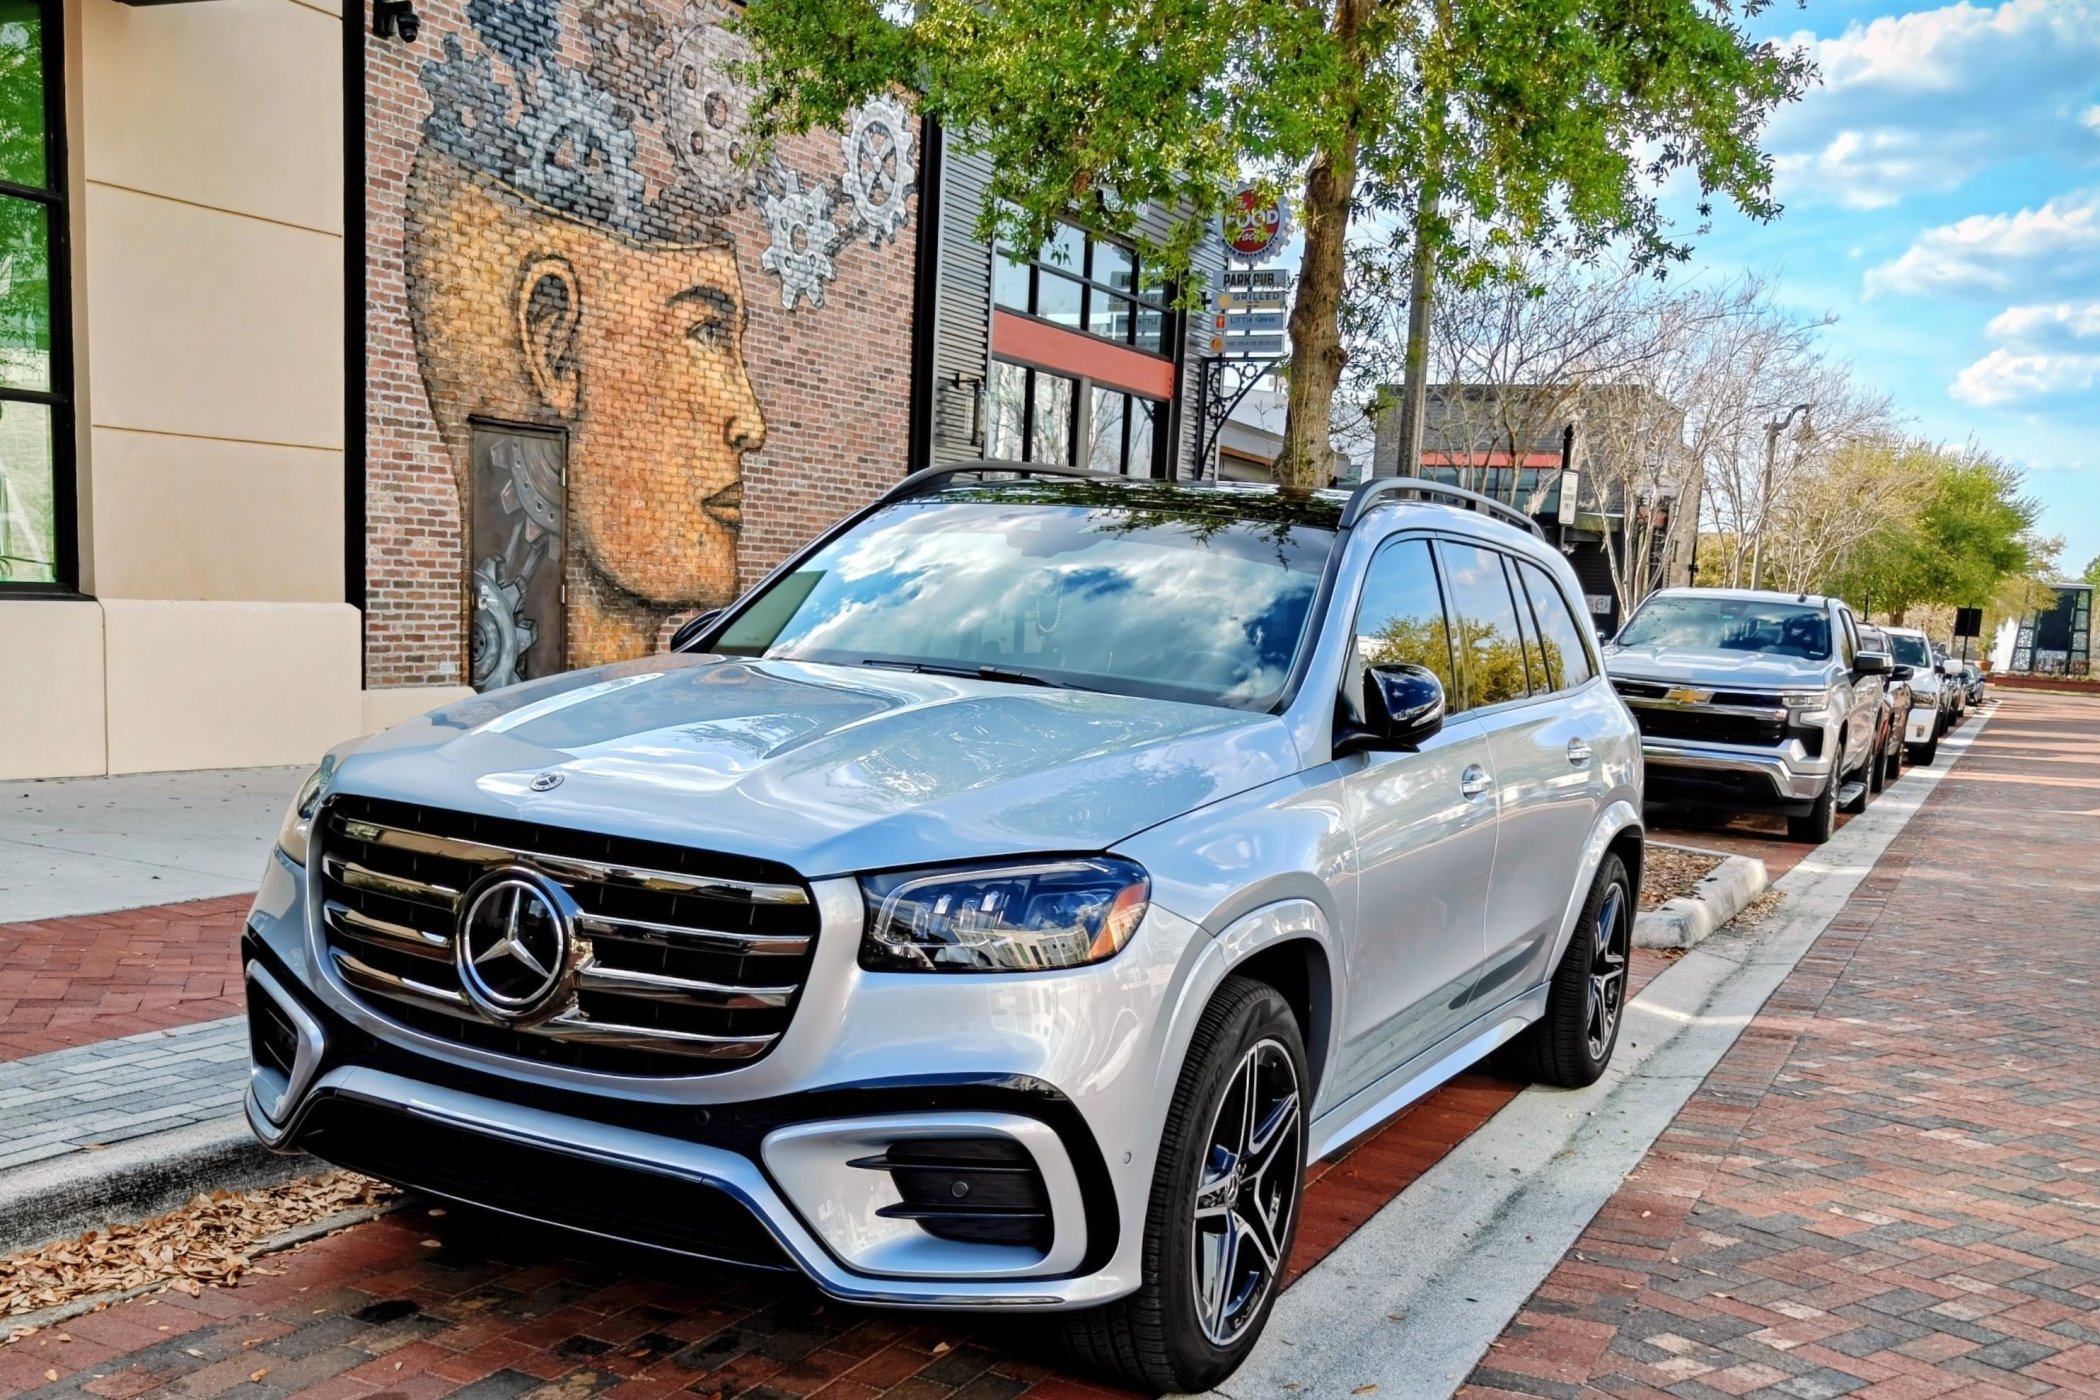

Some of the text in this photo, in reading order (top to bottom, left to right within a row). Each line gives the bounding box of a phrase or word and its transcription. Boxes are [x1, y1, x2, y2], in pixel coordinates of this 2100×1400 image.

[1223, 273, 1274, 287] PARK PUB
[1234, 292, 1280, 300] GRILLED
